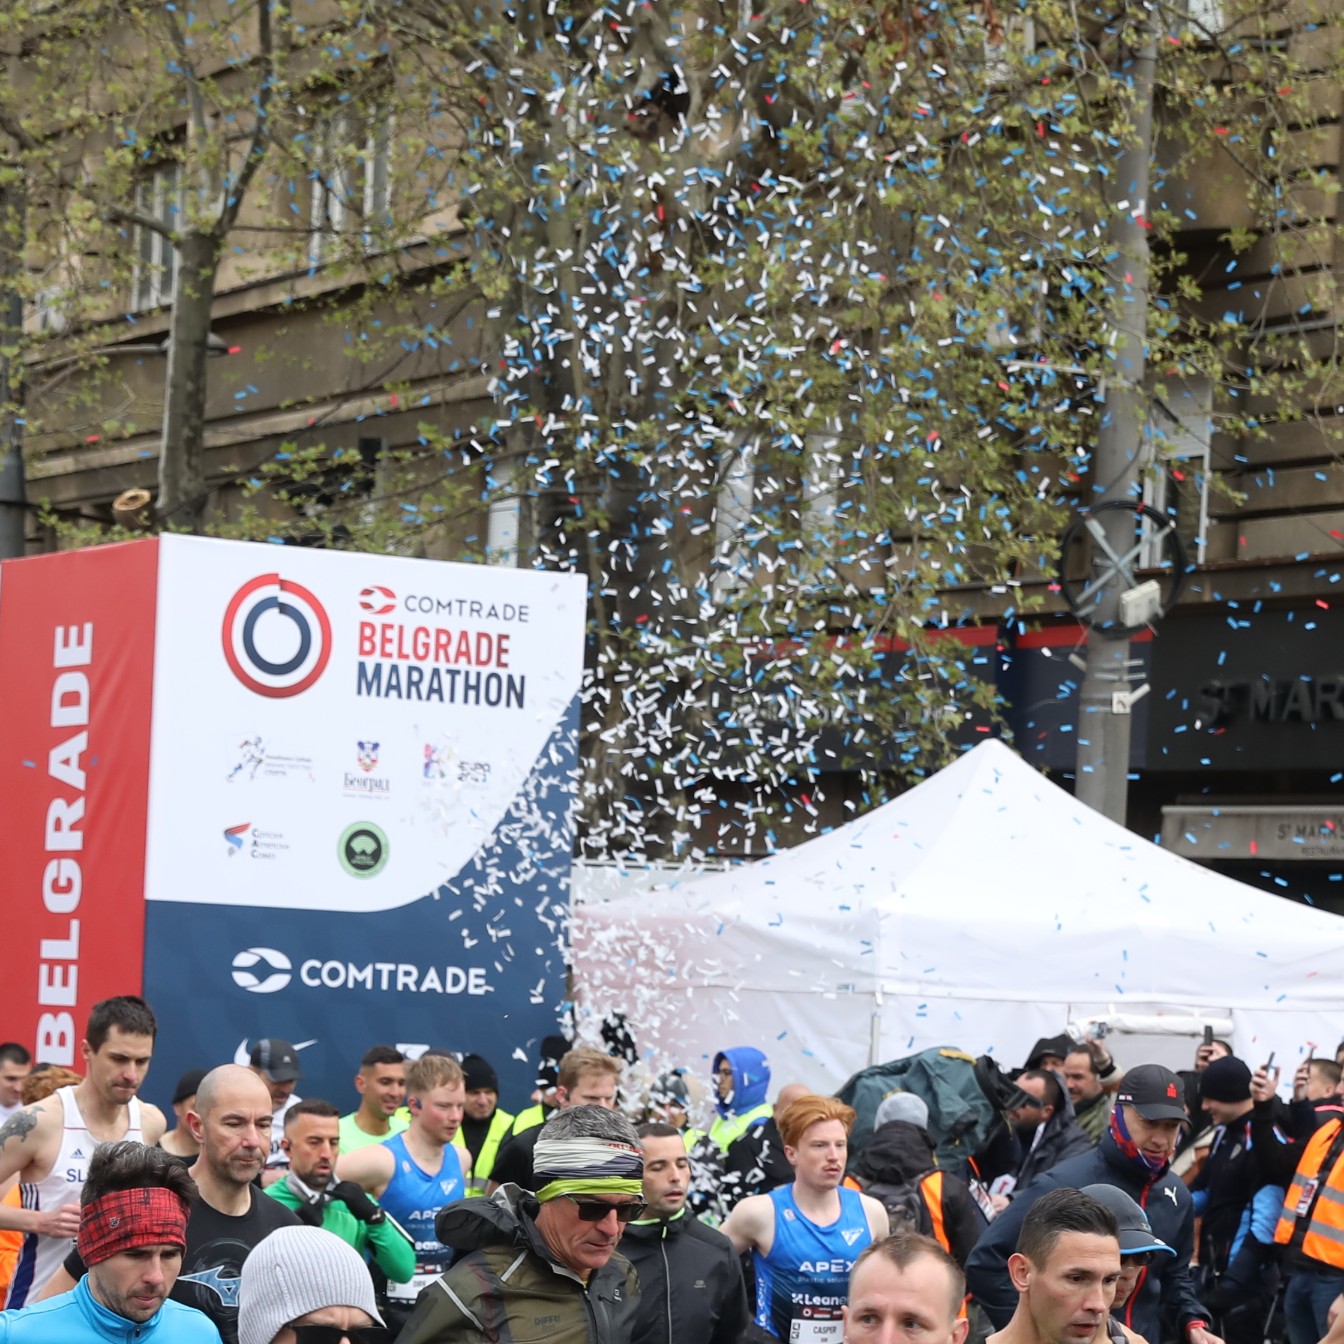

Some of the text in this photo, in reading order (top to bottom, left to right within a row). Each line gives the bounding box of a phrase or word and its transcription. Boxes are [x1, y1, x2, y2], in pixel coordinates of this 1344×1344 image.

[403, 593, 530, 624] COMTRADE
[357, 620, 511, 670] BELGRADE
[355, 660, 527, 711] MARATHON
[34, 621, 94, 1067] BELGRADE
[299, 958, 489, 996] COMTRADE
